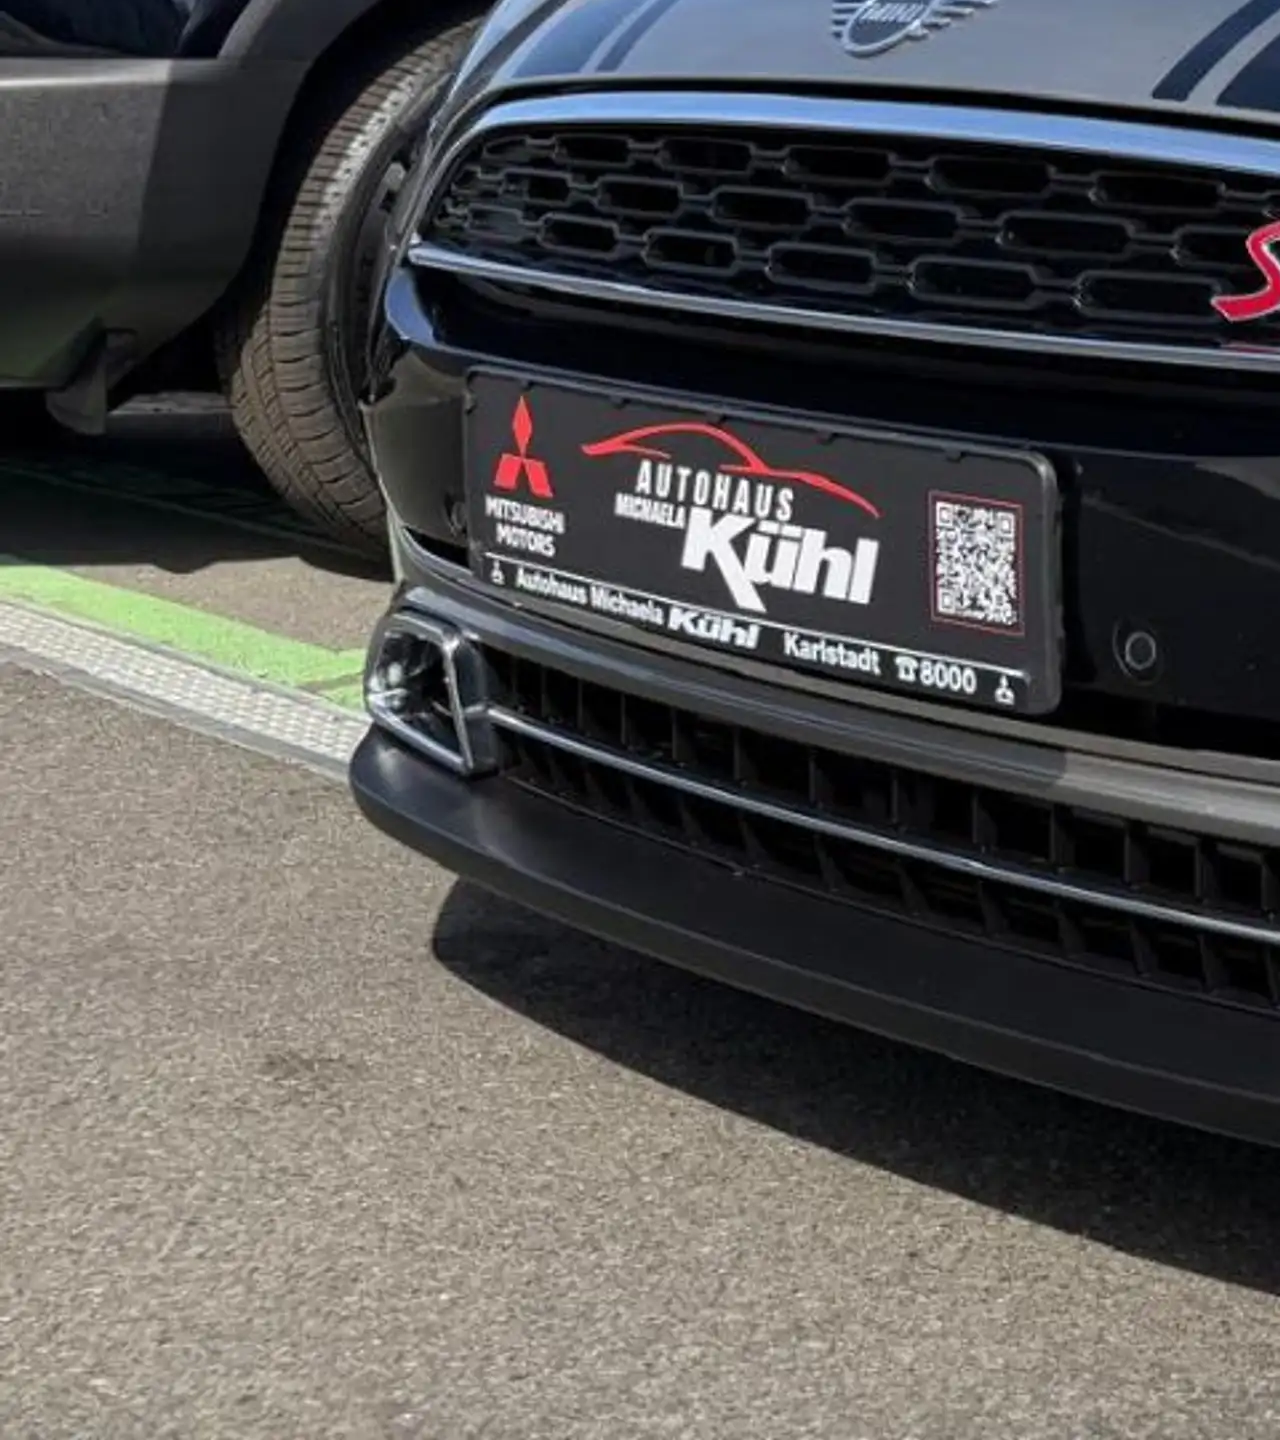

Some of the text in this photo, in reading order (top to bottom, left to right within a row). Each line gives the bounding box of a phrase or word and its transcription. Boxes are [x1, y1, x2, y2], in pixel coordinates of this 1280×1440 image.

[485, 494, 565, 535] MITSUBISHI
[635, 459, 794, 521] AUTOHAUS
[496, 523, 556, 557] MOTORS
[614, 492, 880, 613] MICHAELA Kühl
[516, 566, 977, 694] Autohaus Michaela Kühl Karlstadt 8000
